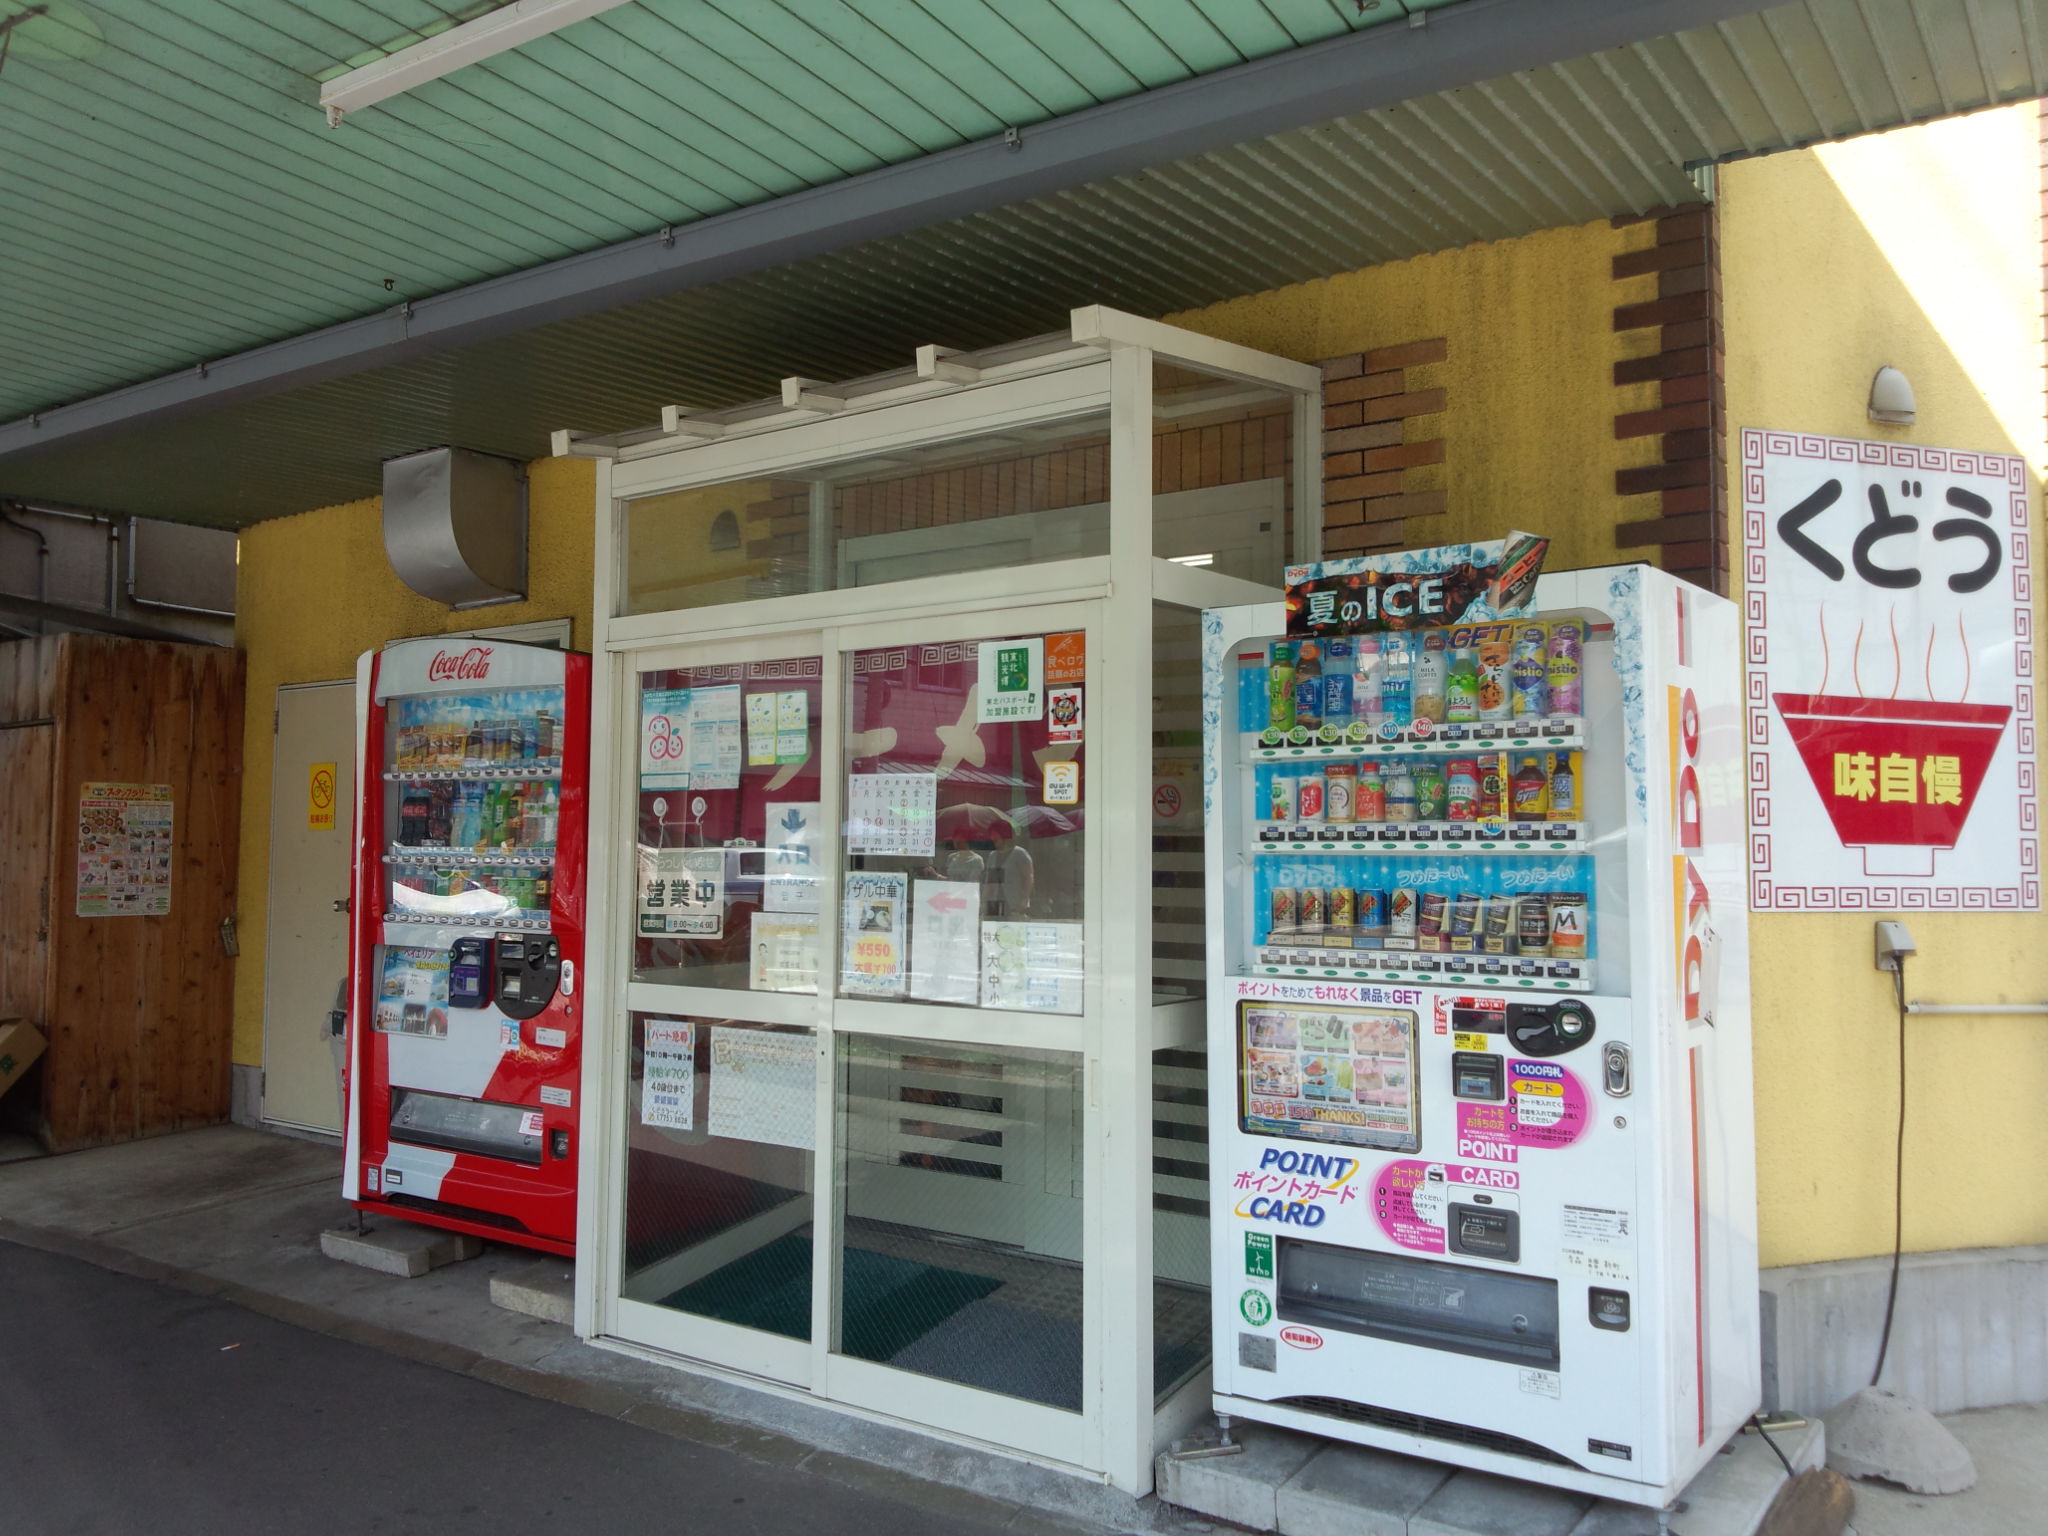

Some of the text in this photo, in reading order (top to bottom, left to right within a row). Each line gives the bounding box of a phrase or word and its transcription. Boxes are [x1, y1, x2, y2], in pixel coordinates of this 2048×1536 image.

[1777, 478, 2001, 594] くどう
[1306, 578, 1444, 626] 夏のICE
[429, 647, 495, 682] Coca-Cola
[1833, 752, 1963, 806] 味自慢
[776, 844, 810, 865] 入口
[646, 878, 716, 908] 営業中
[853, 884, 897, 898] ザル中華
[857, 943, 890, 958] ¥550
[1238, 980, 1422, 1005] ポイントをためてもれなく景品をGET
[1514, 1063, 1563, 1078] 1000円札
[1523, 1083, 1554, 1094] カード
[1459, 1139, 1517, 1162] POINT
[1259, 1148, 1353, 1180] POINT
[1233, 1170, 1359, 1205] ポイントカード
[1461, 1166, 1518, 1188] CARD
[1249, 1197, 1327, 1228] CARD
[1247, 1233, 1270, 1244] Green
[1247, 1239, 1270, 1250] Power
[1249, 1266, 1270, 1277] WIND
